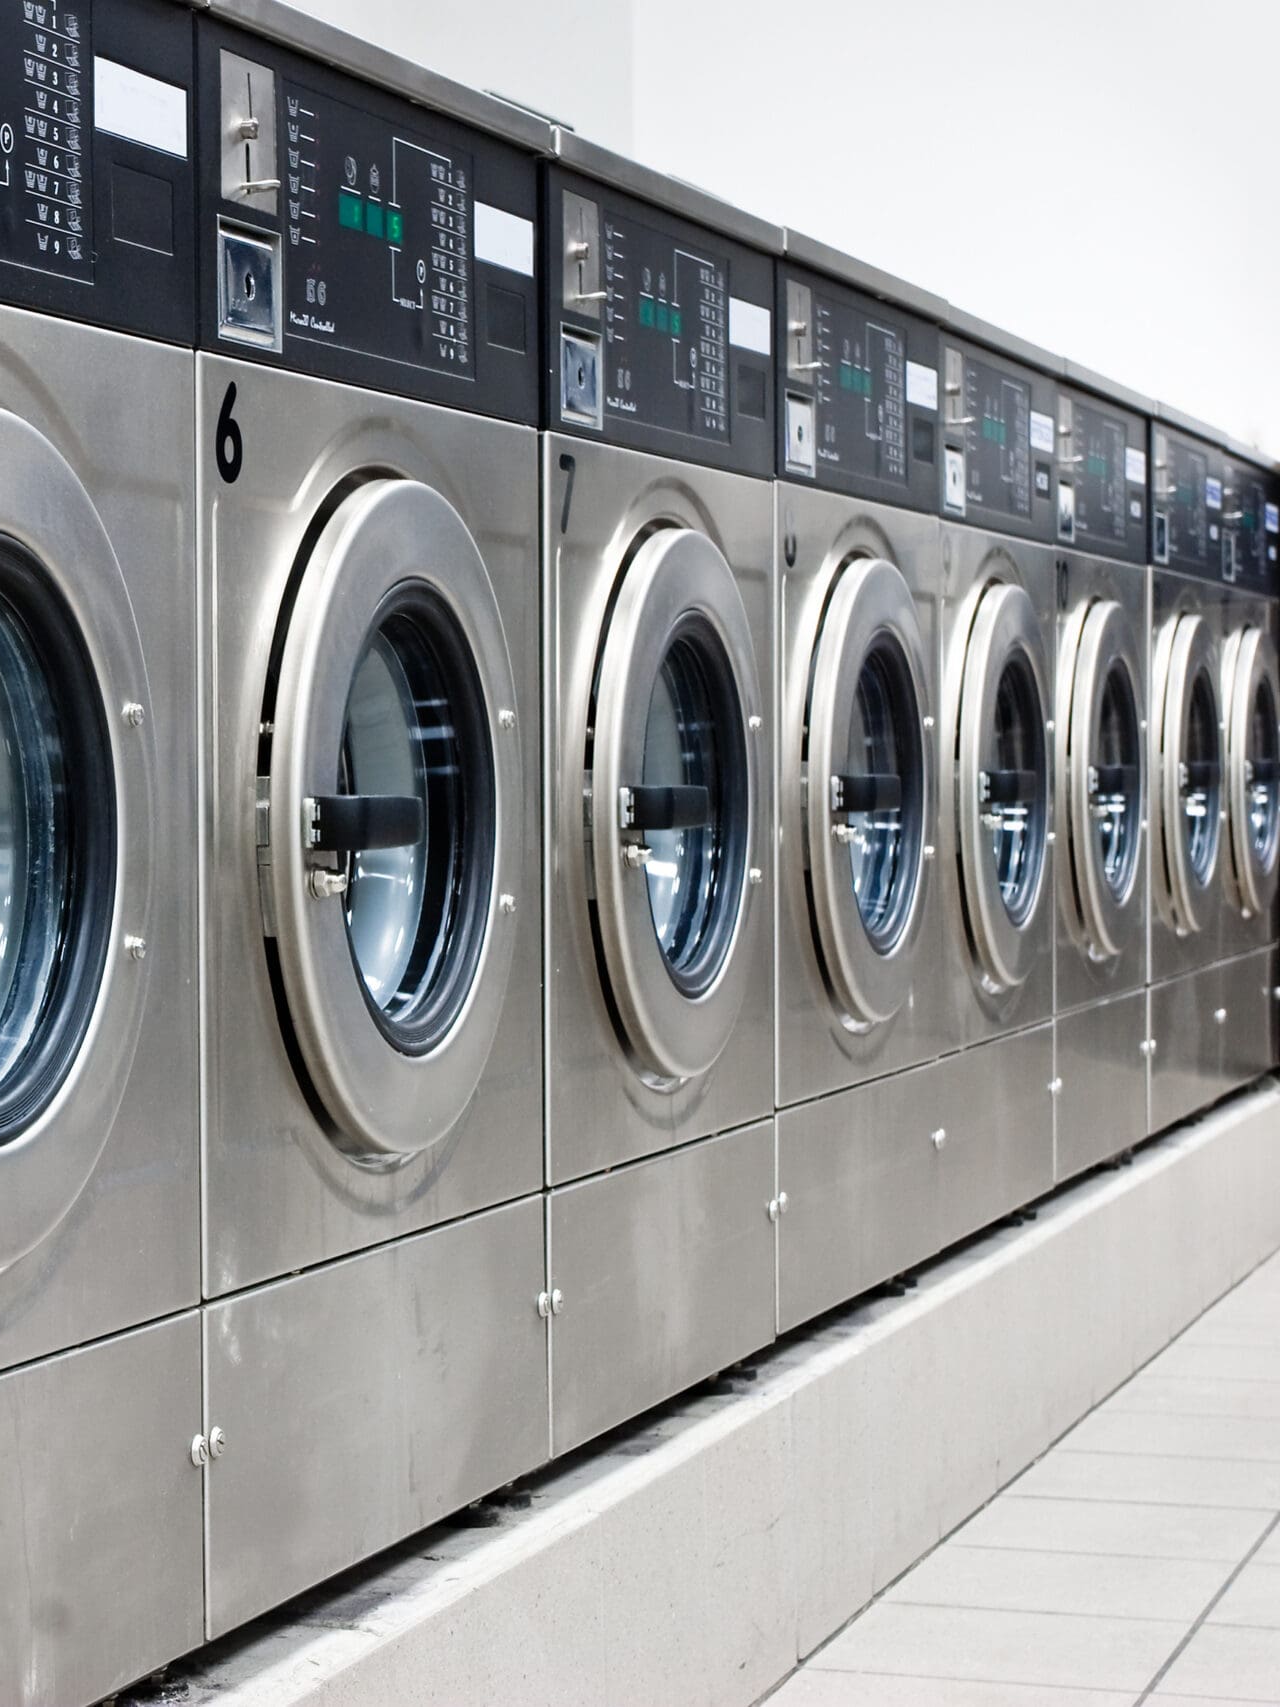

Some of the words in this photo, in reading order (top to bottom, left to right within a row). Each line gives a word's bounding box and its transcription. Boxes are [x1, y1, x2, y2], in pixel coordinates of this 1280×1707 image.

[52, 15, 57, 29] 1
[52, 43, 58, 58] 2
[52, 71, 58, 86] 3
[52, 99, 58, 114] 4
[53, 127, 59, 141] 5
[53, 155, 60, 169] 6
[53, 181, 59, 195] 7
[54, 210, 60, 224] 8
[54, 240, 60, 254] 9
[216, 381, 242, 484] 6
[559, 453, 576, 534] 7
[1056, 560, 1069, 611] 10
